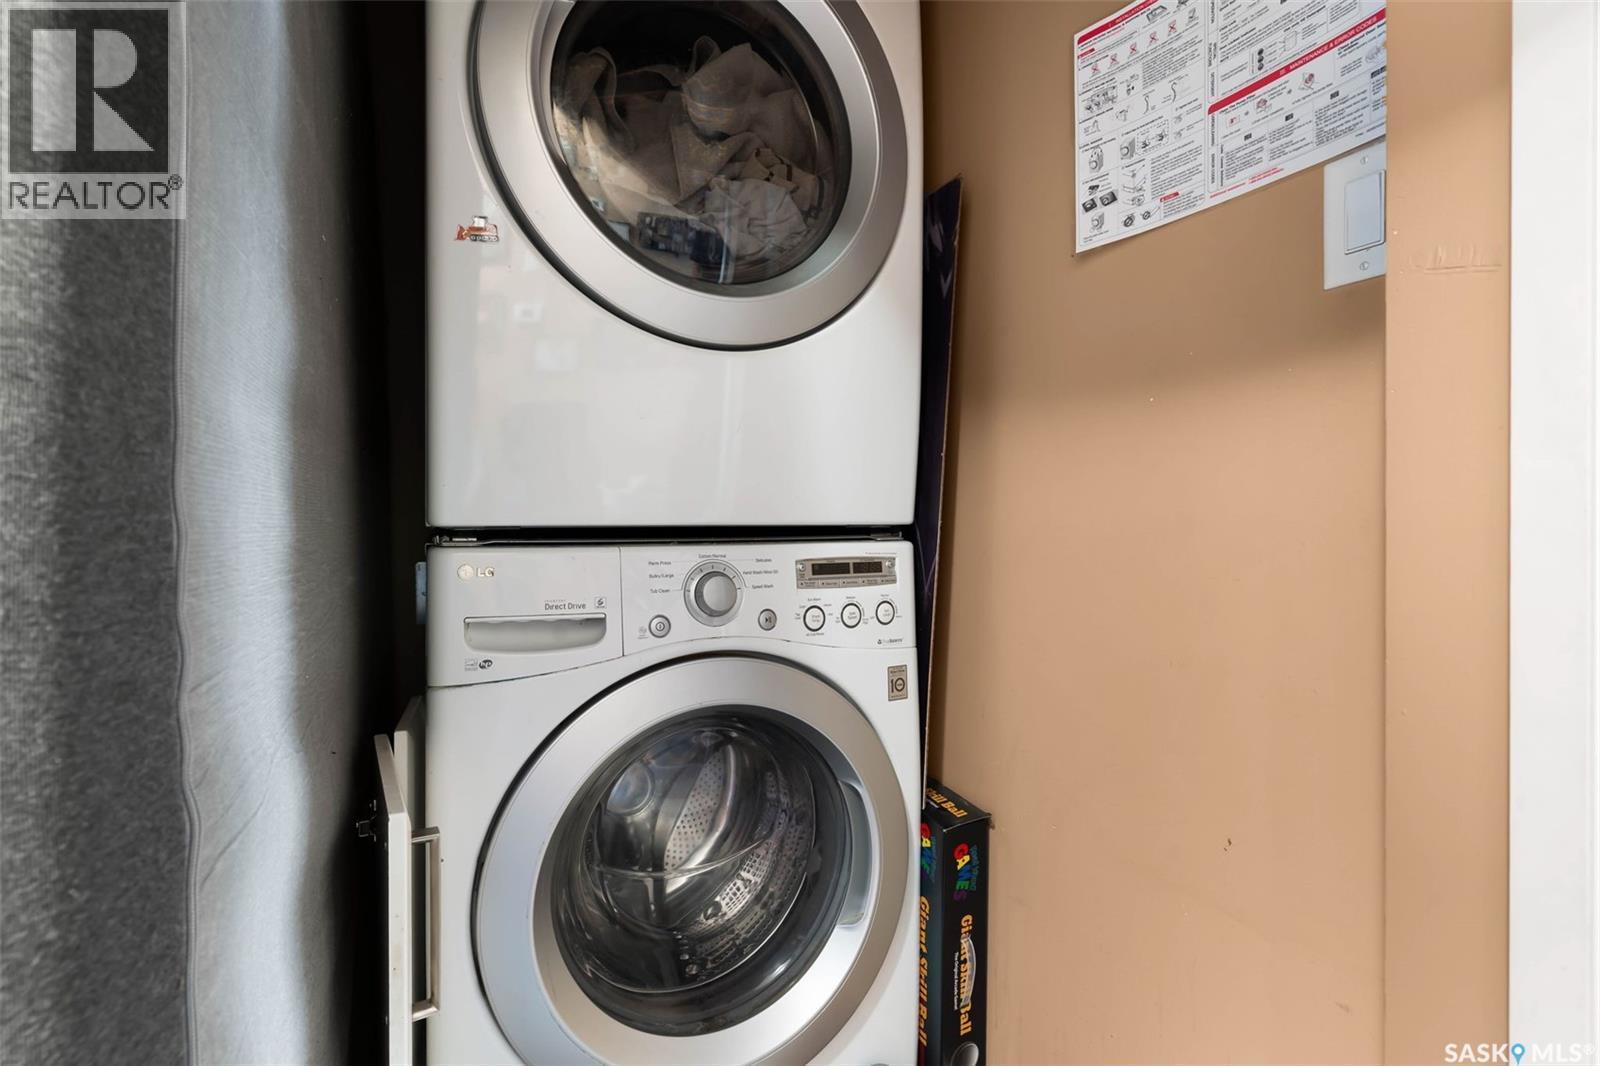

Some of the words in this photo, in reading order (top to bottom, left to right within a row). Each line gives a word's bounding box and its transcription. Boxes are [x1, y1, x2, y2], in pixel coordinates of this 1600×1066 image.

[1289, 46, 1329, 69] MAINTENANCE
[1334, 28, 1356, 46] ERROR
[1355, 16, 1377, 33] CODES
[475, 567, 495, 578] LG
[544, 602, 567, 611] Direct
[567, 600, 587, 611] Drive
[940, 801, 968, 818] Ball
[952, 843, 973, 901] GAMES
[959, 1002, 973, 1036] Ball
